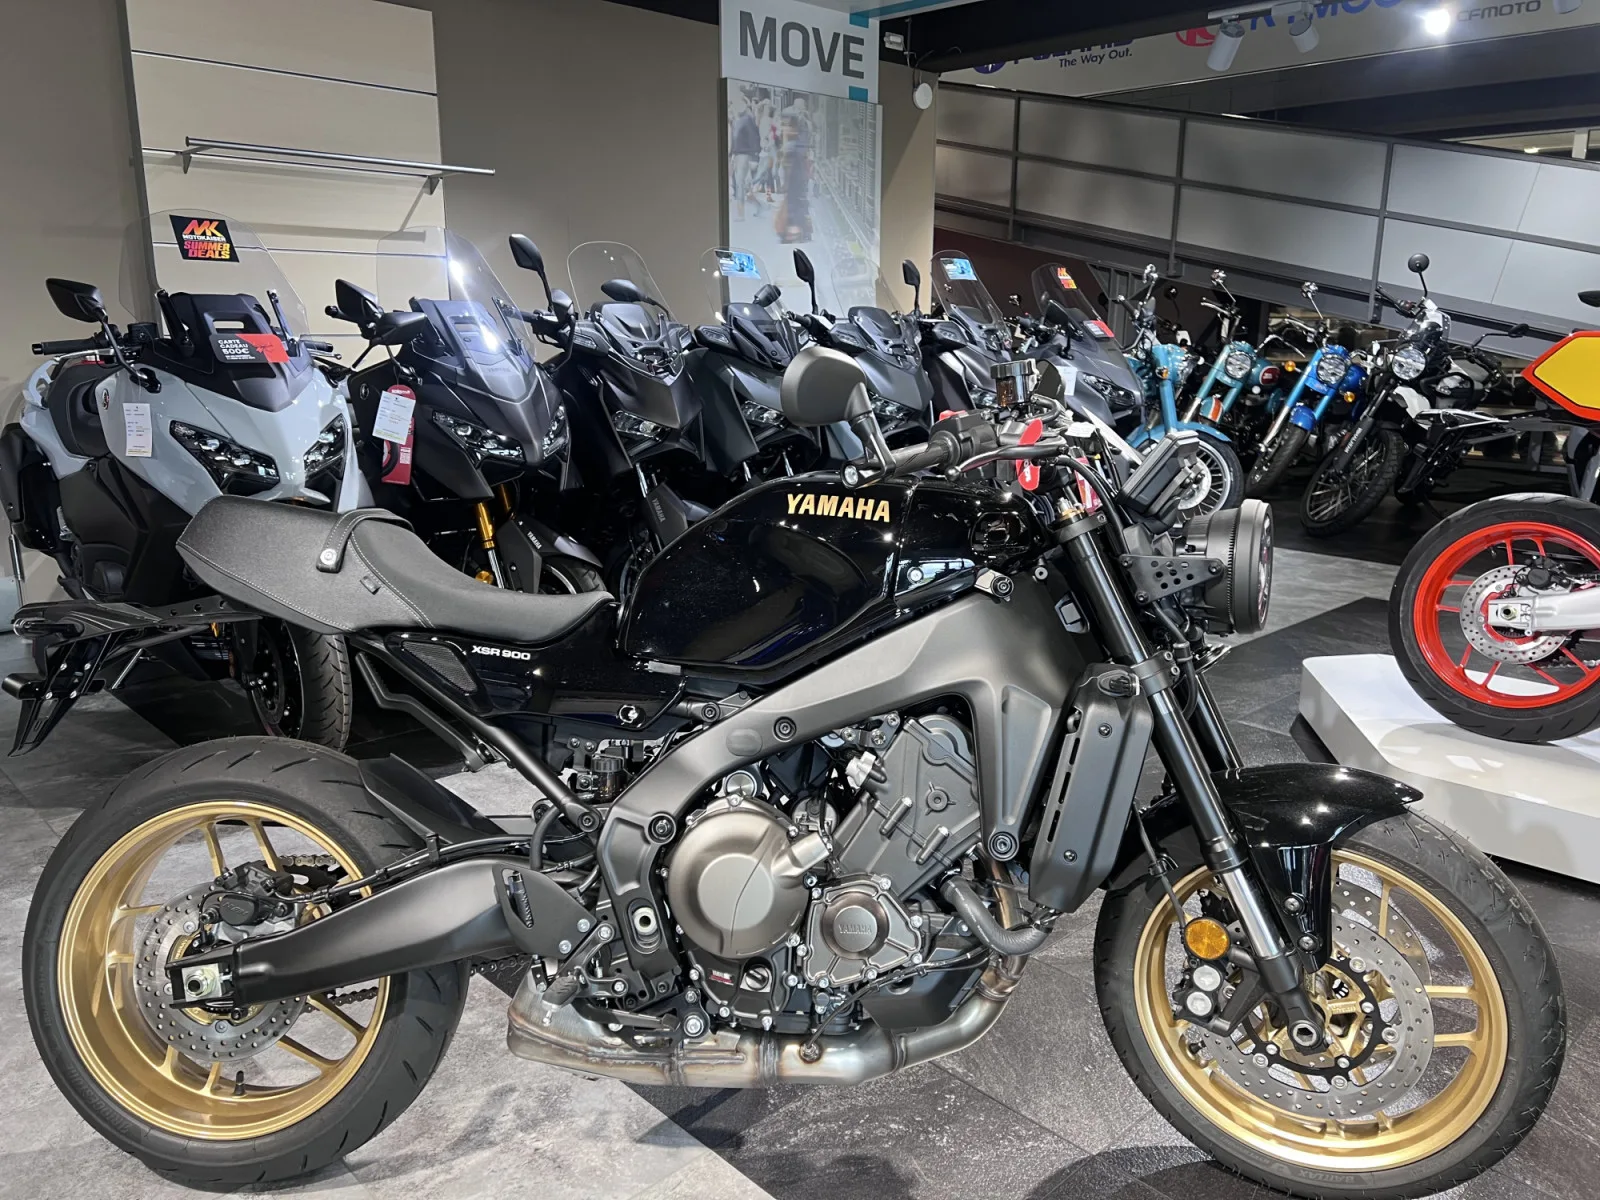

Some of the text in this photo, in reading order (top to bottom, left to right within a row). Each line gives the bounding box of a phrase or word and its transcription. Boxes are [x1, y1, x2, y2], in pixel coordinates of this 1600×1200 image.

[1457, 0, 1542, 21] CFMOTO
[739, 10, 865, 79] MOVE
[1059, 58, 1077, 69] The
[1081, 53, 1105, 65] Way
[1109, 48, 1133, 60] Out.
[184, 240, 231, 251] SUMMER
[188, 249, 231, 259] DEALS
[652, 498, 666, 522] YAMAHA
[787, 493, 890, 523] YAMAHA
[527, 531, 542, 550] YAMAHA
[471, 645, 531, 661] XSR 900
[838, 923, 873, 935] YAMAHA
